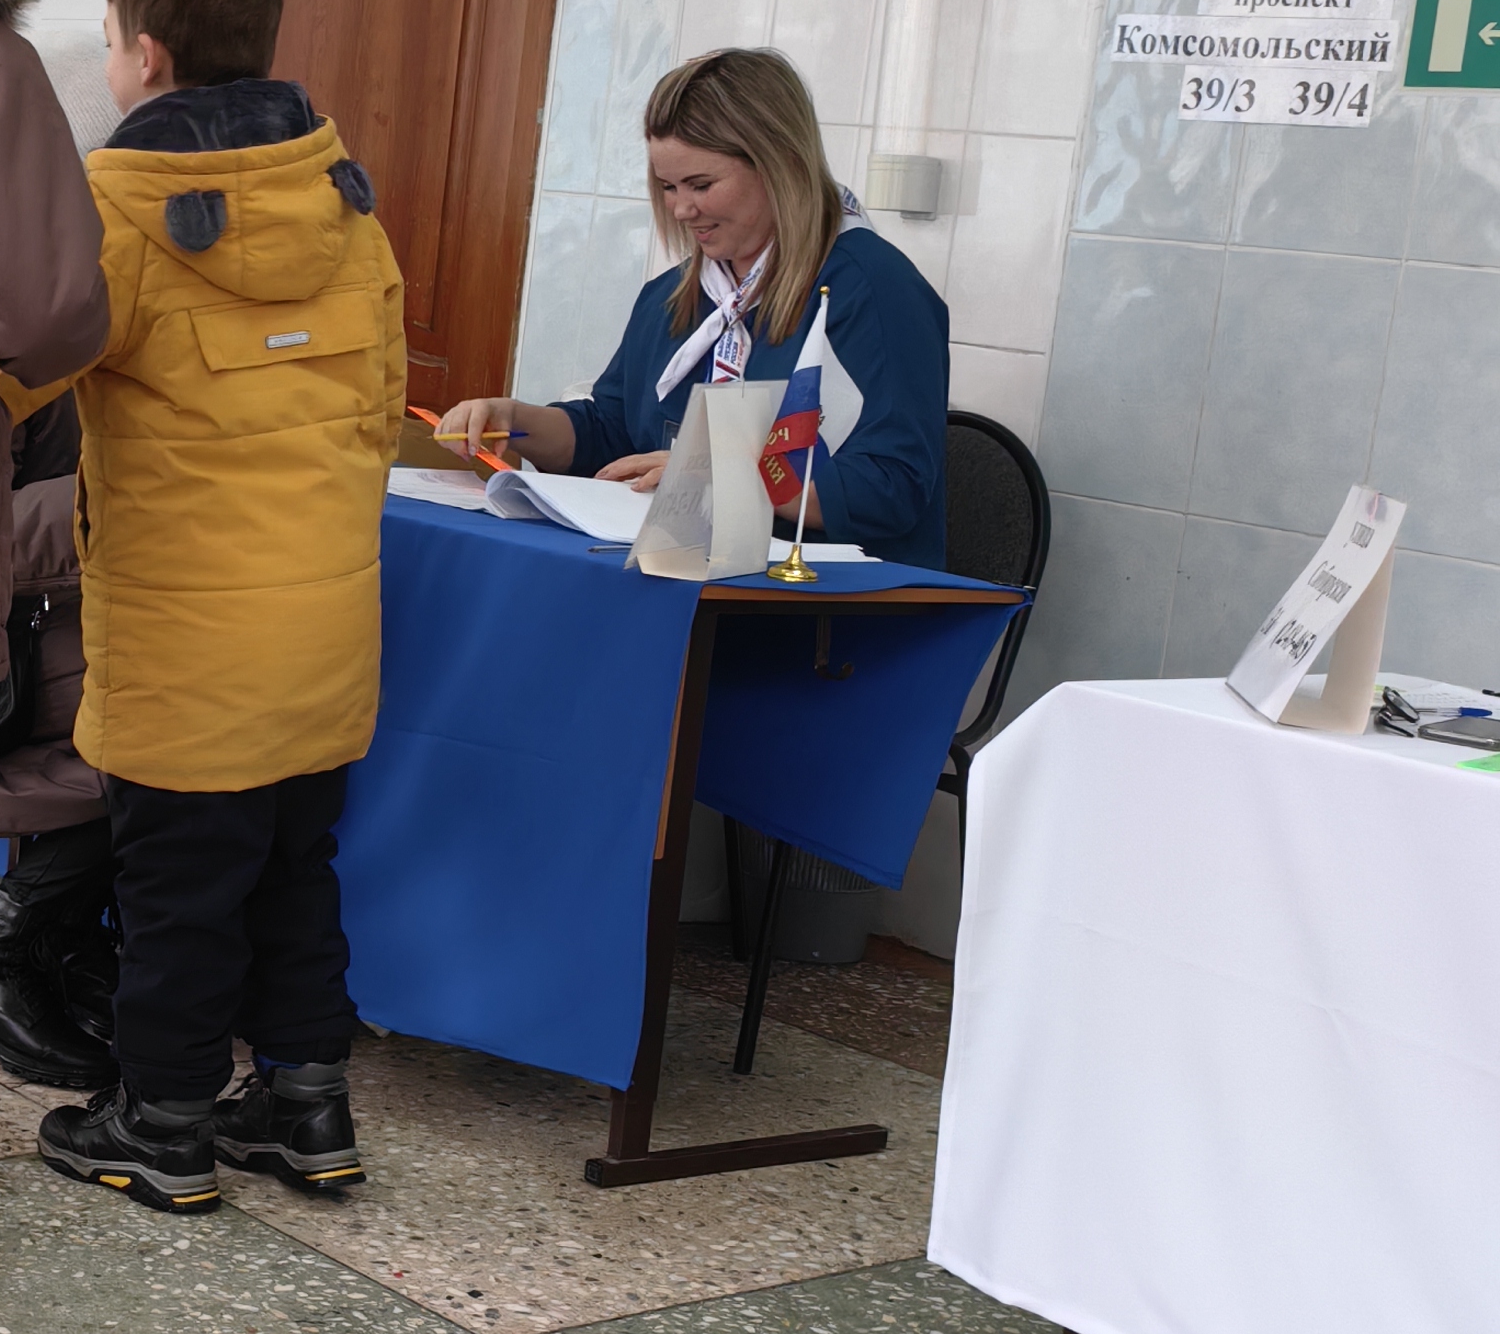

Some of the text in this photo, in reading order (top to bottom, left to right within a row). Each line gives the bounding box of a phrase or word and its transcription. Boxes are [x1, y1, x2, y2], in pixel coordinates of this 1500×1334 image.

[1113, 24, 1391, 63] Комсомольский
[1182, 77, 1369, 117] 39/3 39/4
